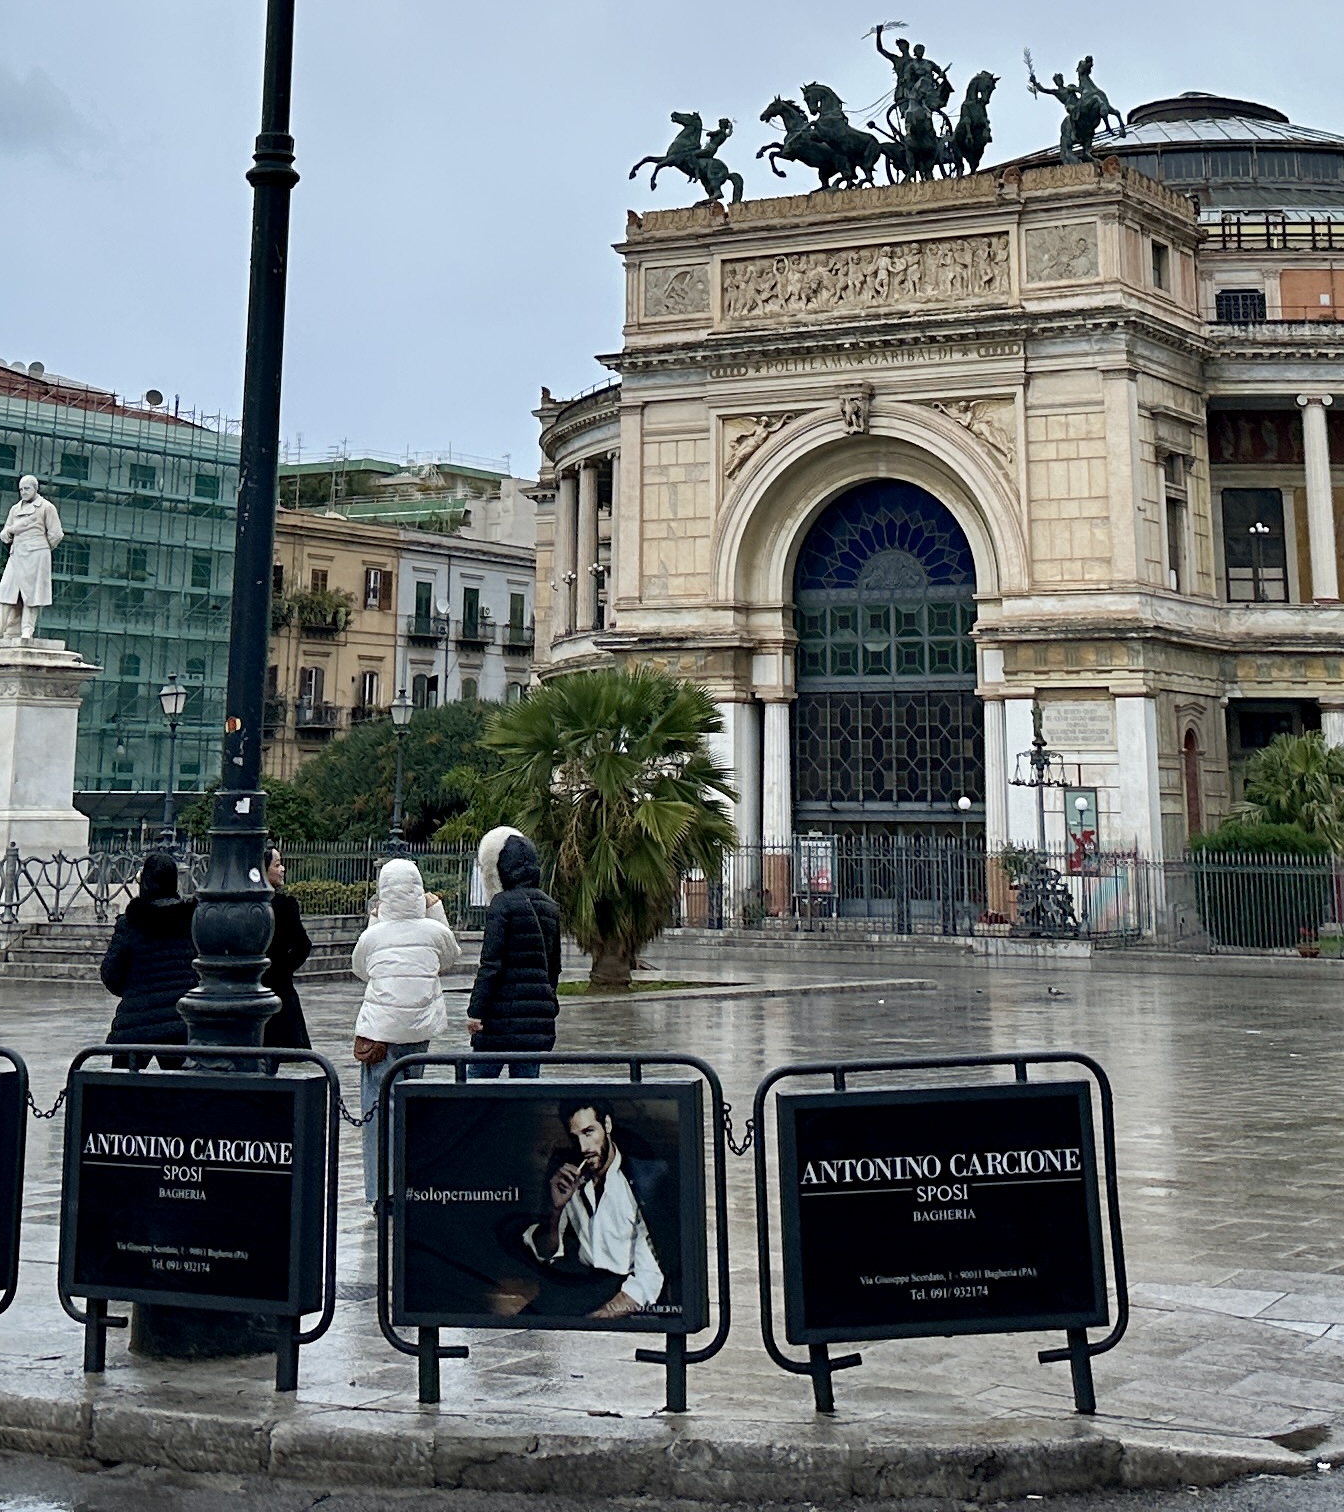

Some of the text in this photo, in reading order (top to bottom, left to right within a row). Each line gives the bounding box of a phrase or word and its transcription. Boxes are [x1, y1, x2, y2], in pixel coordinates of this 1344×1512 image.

[766, 348, 954, 372] POLITEAMA GARIBALDI
[83, 1133, 293, 1165] ANTONINO CARCIONE
[163, 1165, 203, 1182] SPOSI
[800, 1148, 1082, 1185] ANTONINO CARCIONE
[159, 1187, 206, 1200] BAGHERIA
[406, 1186, 519, 1205] #solopernumeri1
[917, 1184, 968, 1202] SPOSI
[913, 1208, 976, 1222] BAGHERIA
[860, 1276, 873, 1285] Via
[910, 1289, 928, 1300] Tel.
[954, 1285, 988, 1298] 932174
